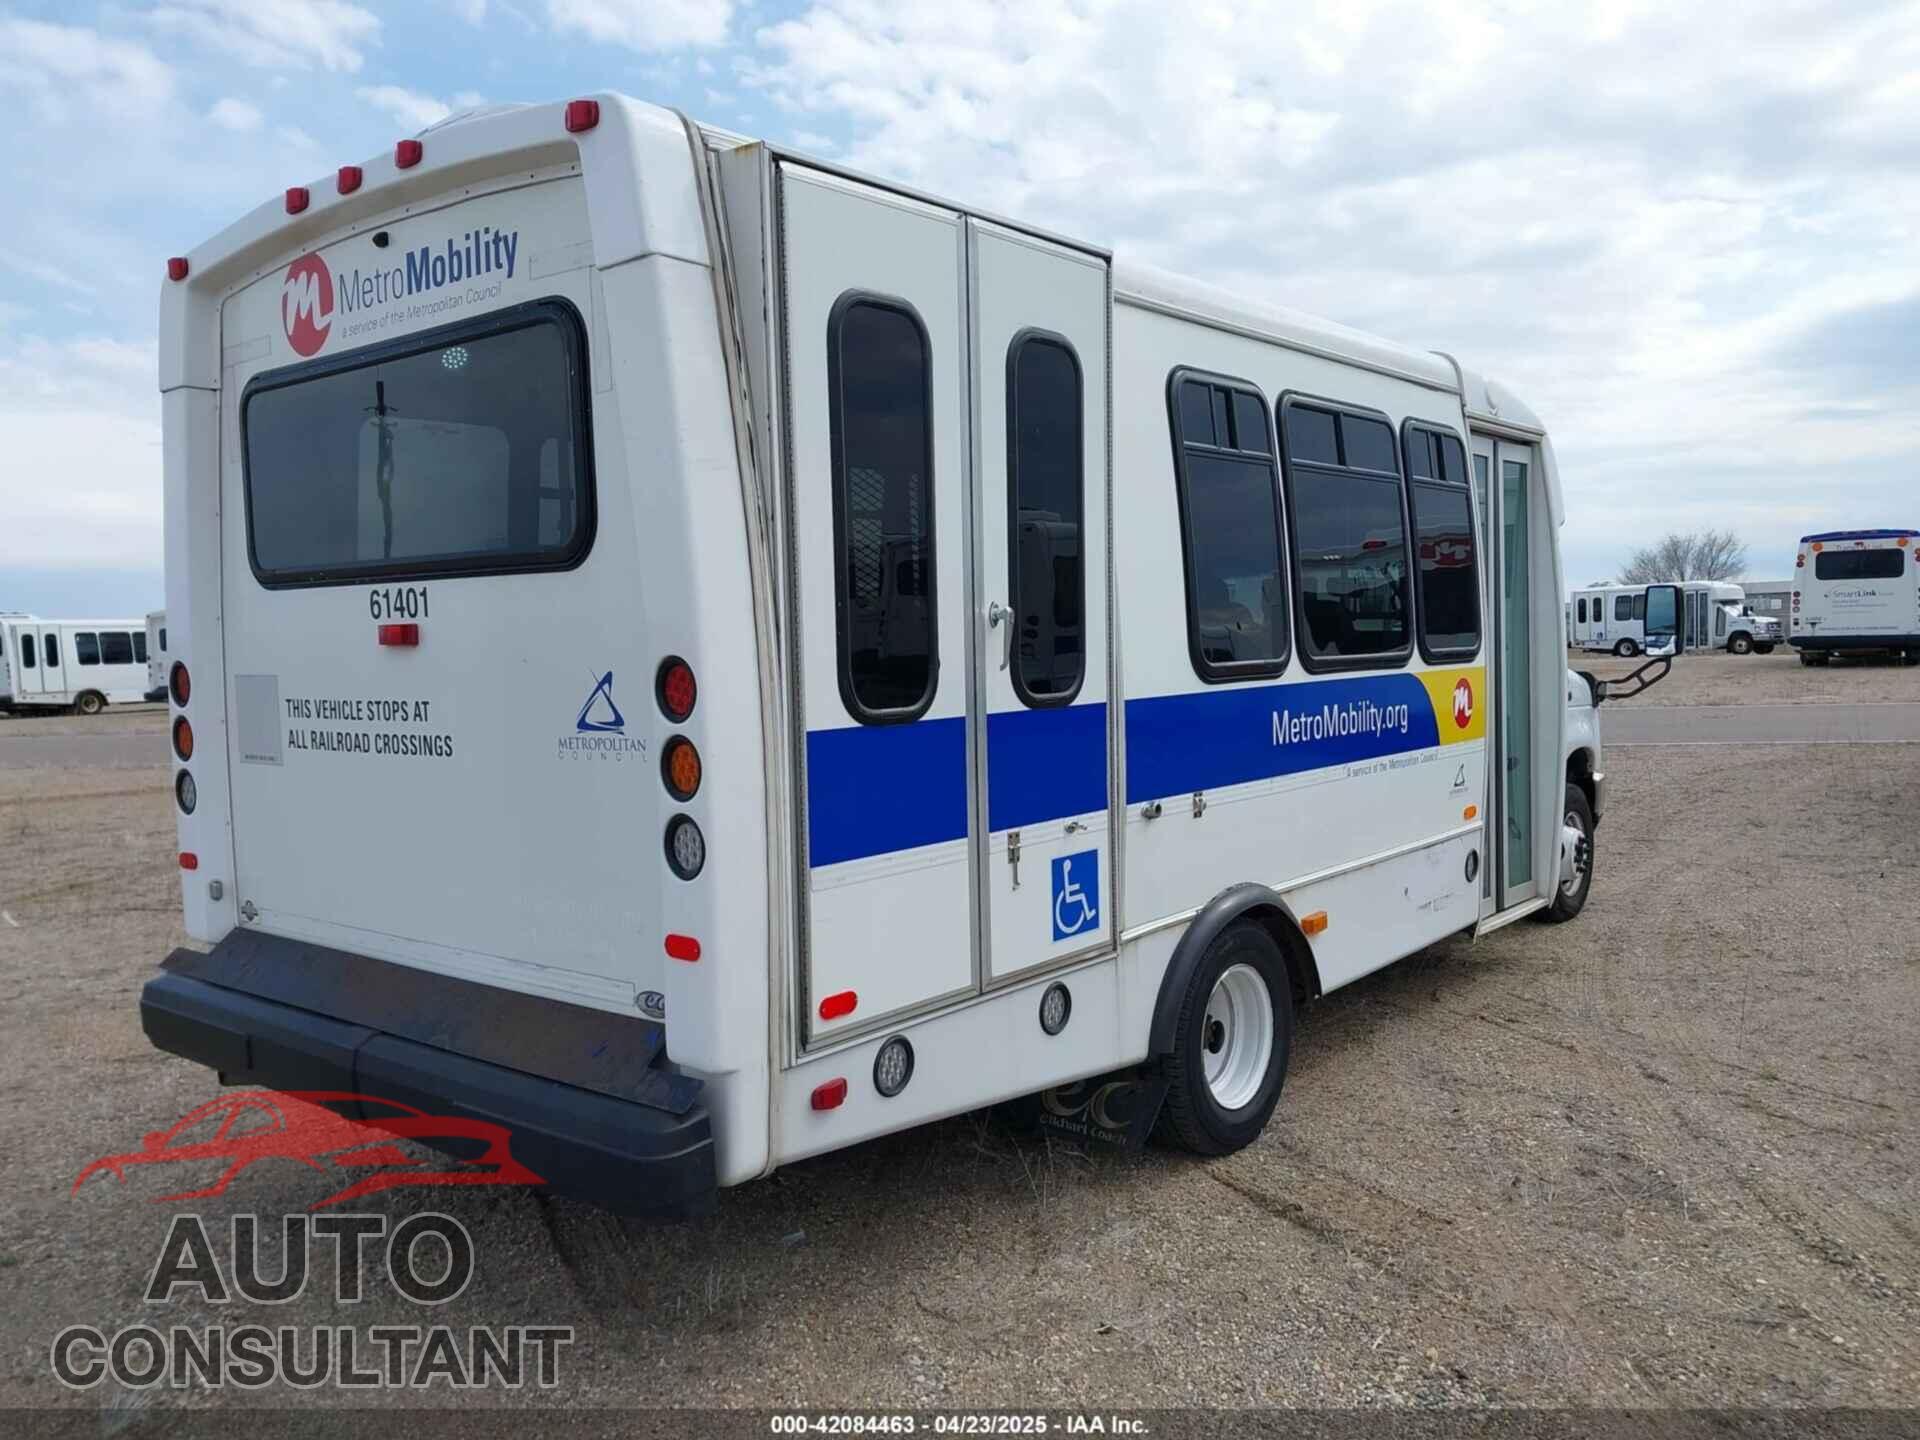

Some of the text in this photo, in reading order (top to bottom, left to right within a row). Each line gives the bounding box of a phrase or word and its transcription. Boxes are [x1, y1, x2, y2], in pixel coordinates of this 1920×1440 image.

[338, 226, 518, 315] MetroMobility
[348, 318, 377, 337] service
[379, 312, 389, 328] of
[391, 309, 406, 323] the
[406, 294, 464, 320] Metropolitan
[465, 281, 502, 305] Council
[369, 586, 430, 620] 61401
[285, 699, 430, 723] THIS VEHICLE STOPS AT
[1272, 700, 1409, 746] MetroMobility.org
[288, 729, 453, 757] ALL RAILROAD CROSSINGS
[558, 736, 647, 752] METROPOLITAN
[558, 751, 648, 763] COUNCIL
